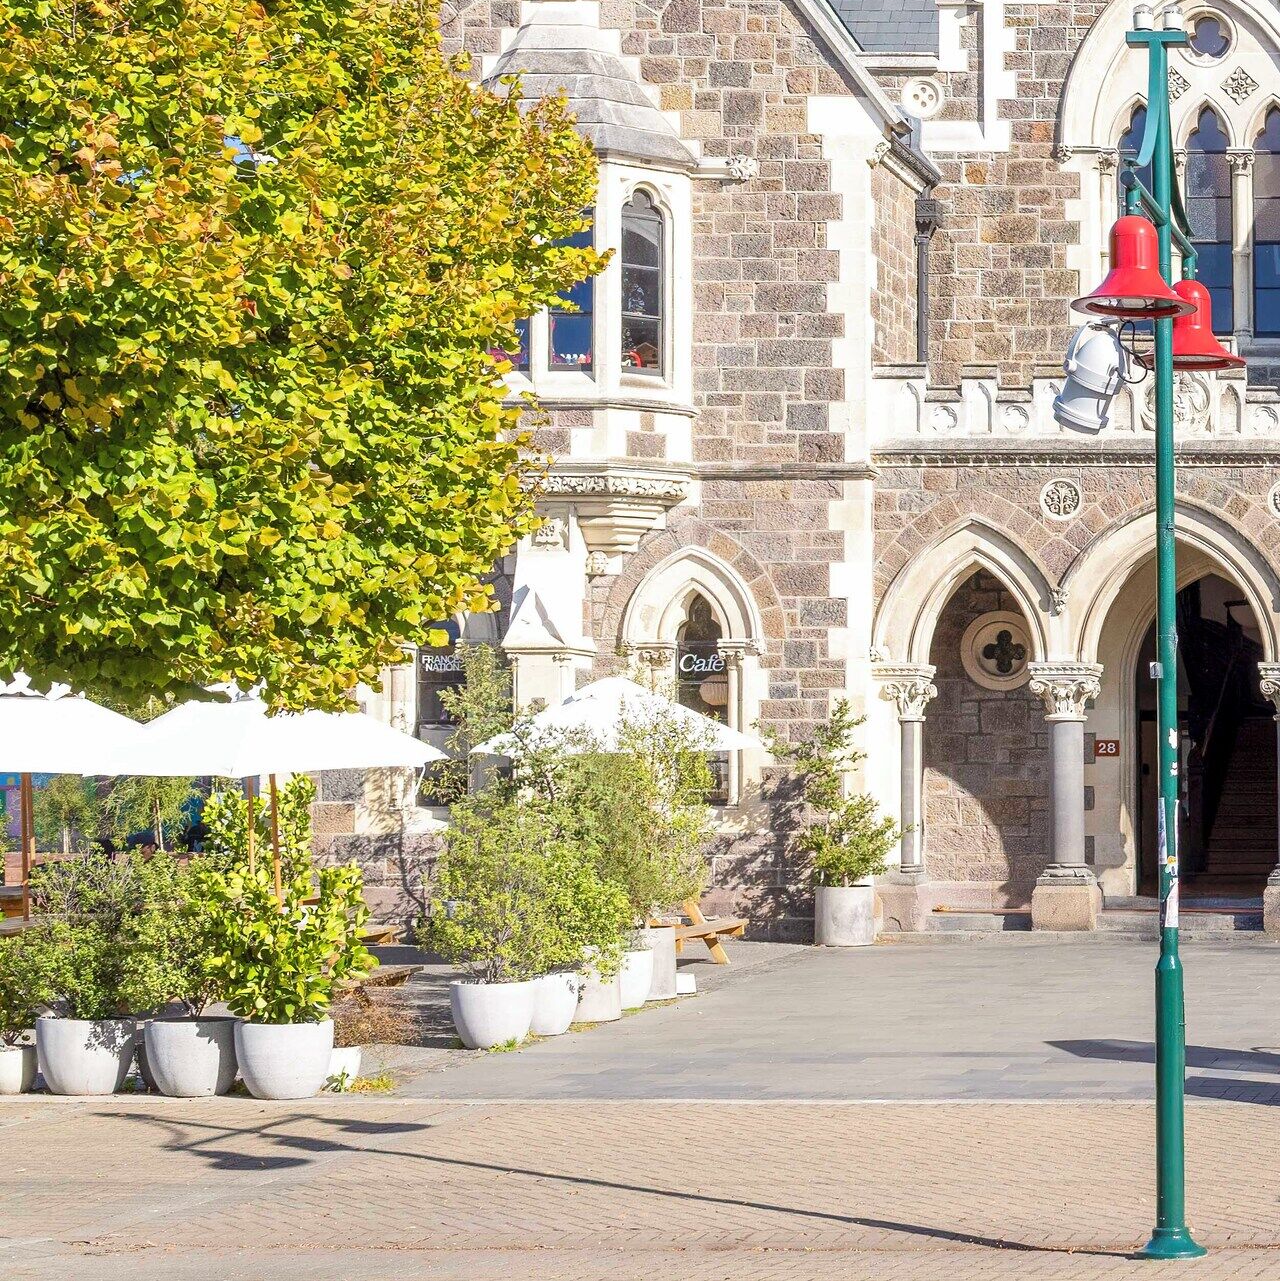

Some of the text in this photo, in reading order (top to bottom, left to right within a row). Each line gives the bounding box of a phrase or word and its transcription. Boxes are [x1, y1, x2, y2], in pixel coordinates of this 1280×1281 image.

[422, 655, 464, 664] FRANCES
[425, 663, 461, 672] NATION
[1098, 742, 1116, 754] 28
